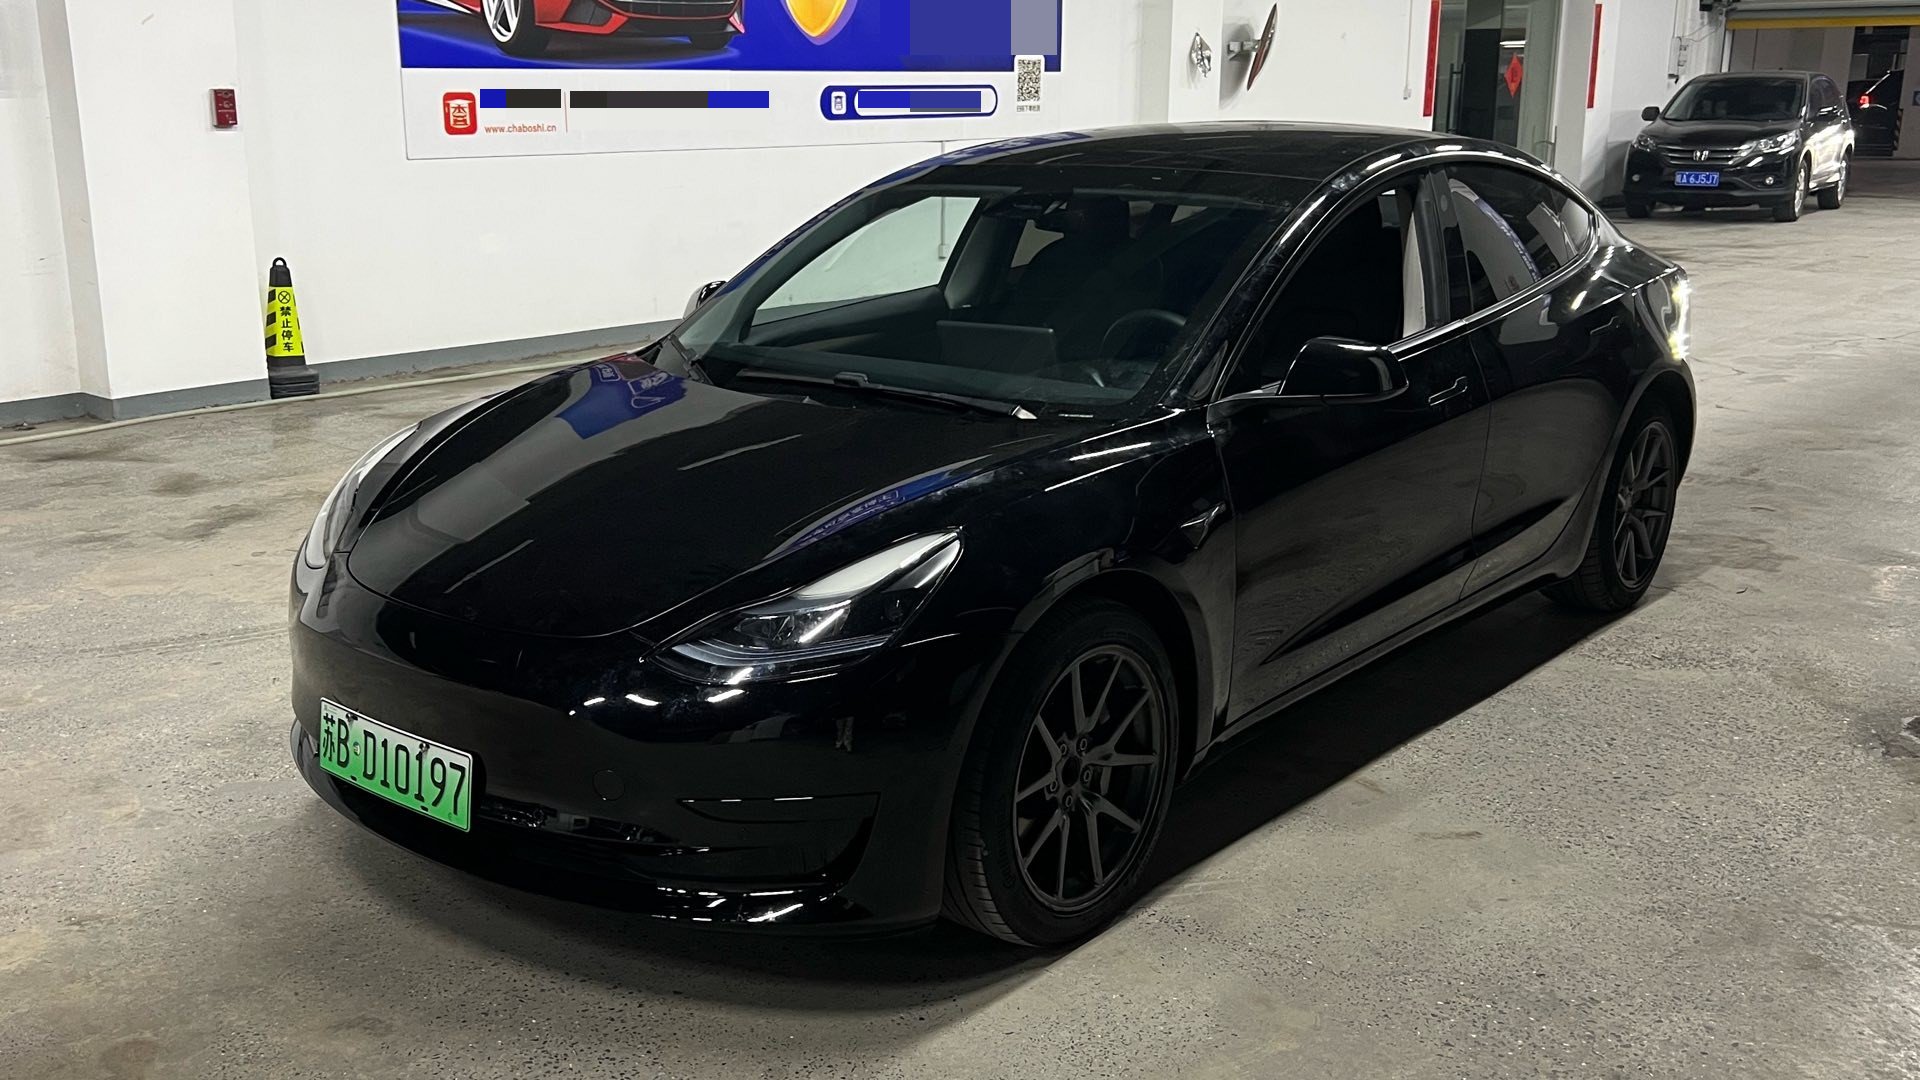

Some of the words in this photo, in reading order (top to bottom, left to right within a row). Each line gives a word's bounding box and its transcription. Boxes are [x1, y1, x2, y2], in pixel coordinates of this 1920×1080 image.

[484, 123, 557, 134] www.chaboshi.cn
[280, 306, 294, 352] 禁止停车
